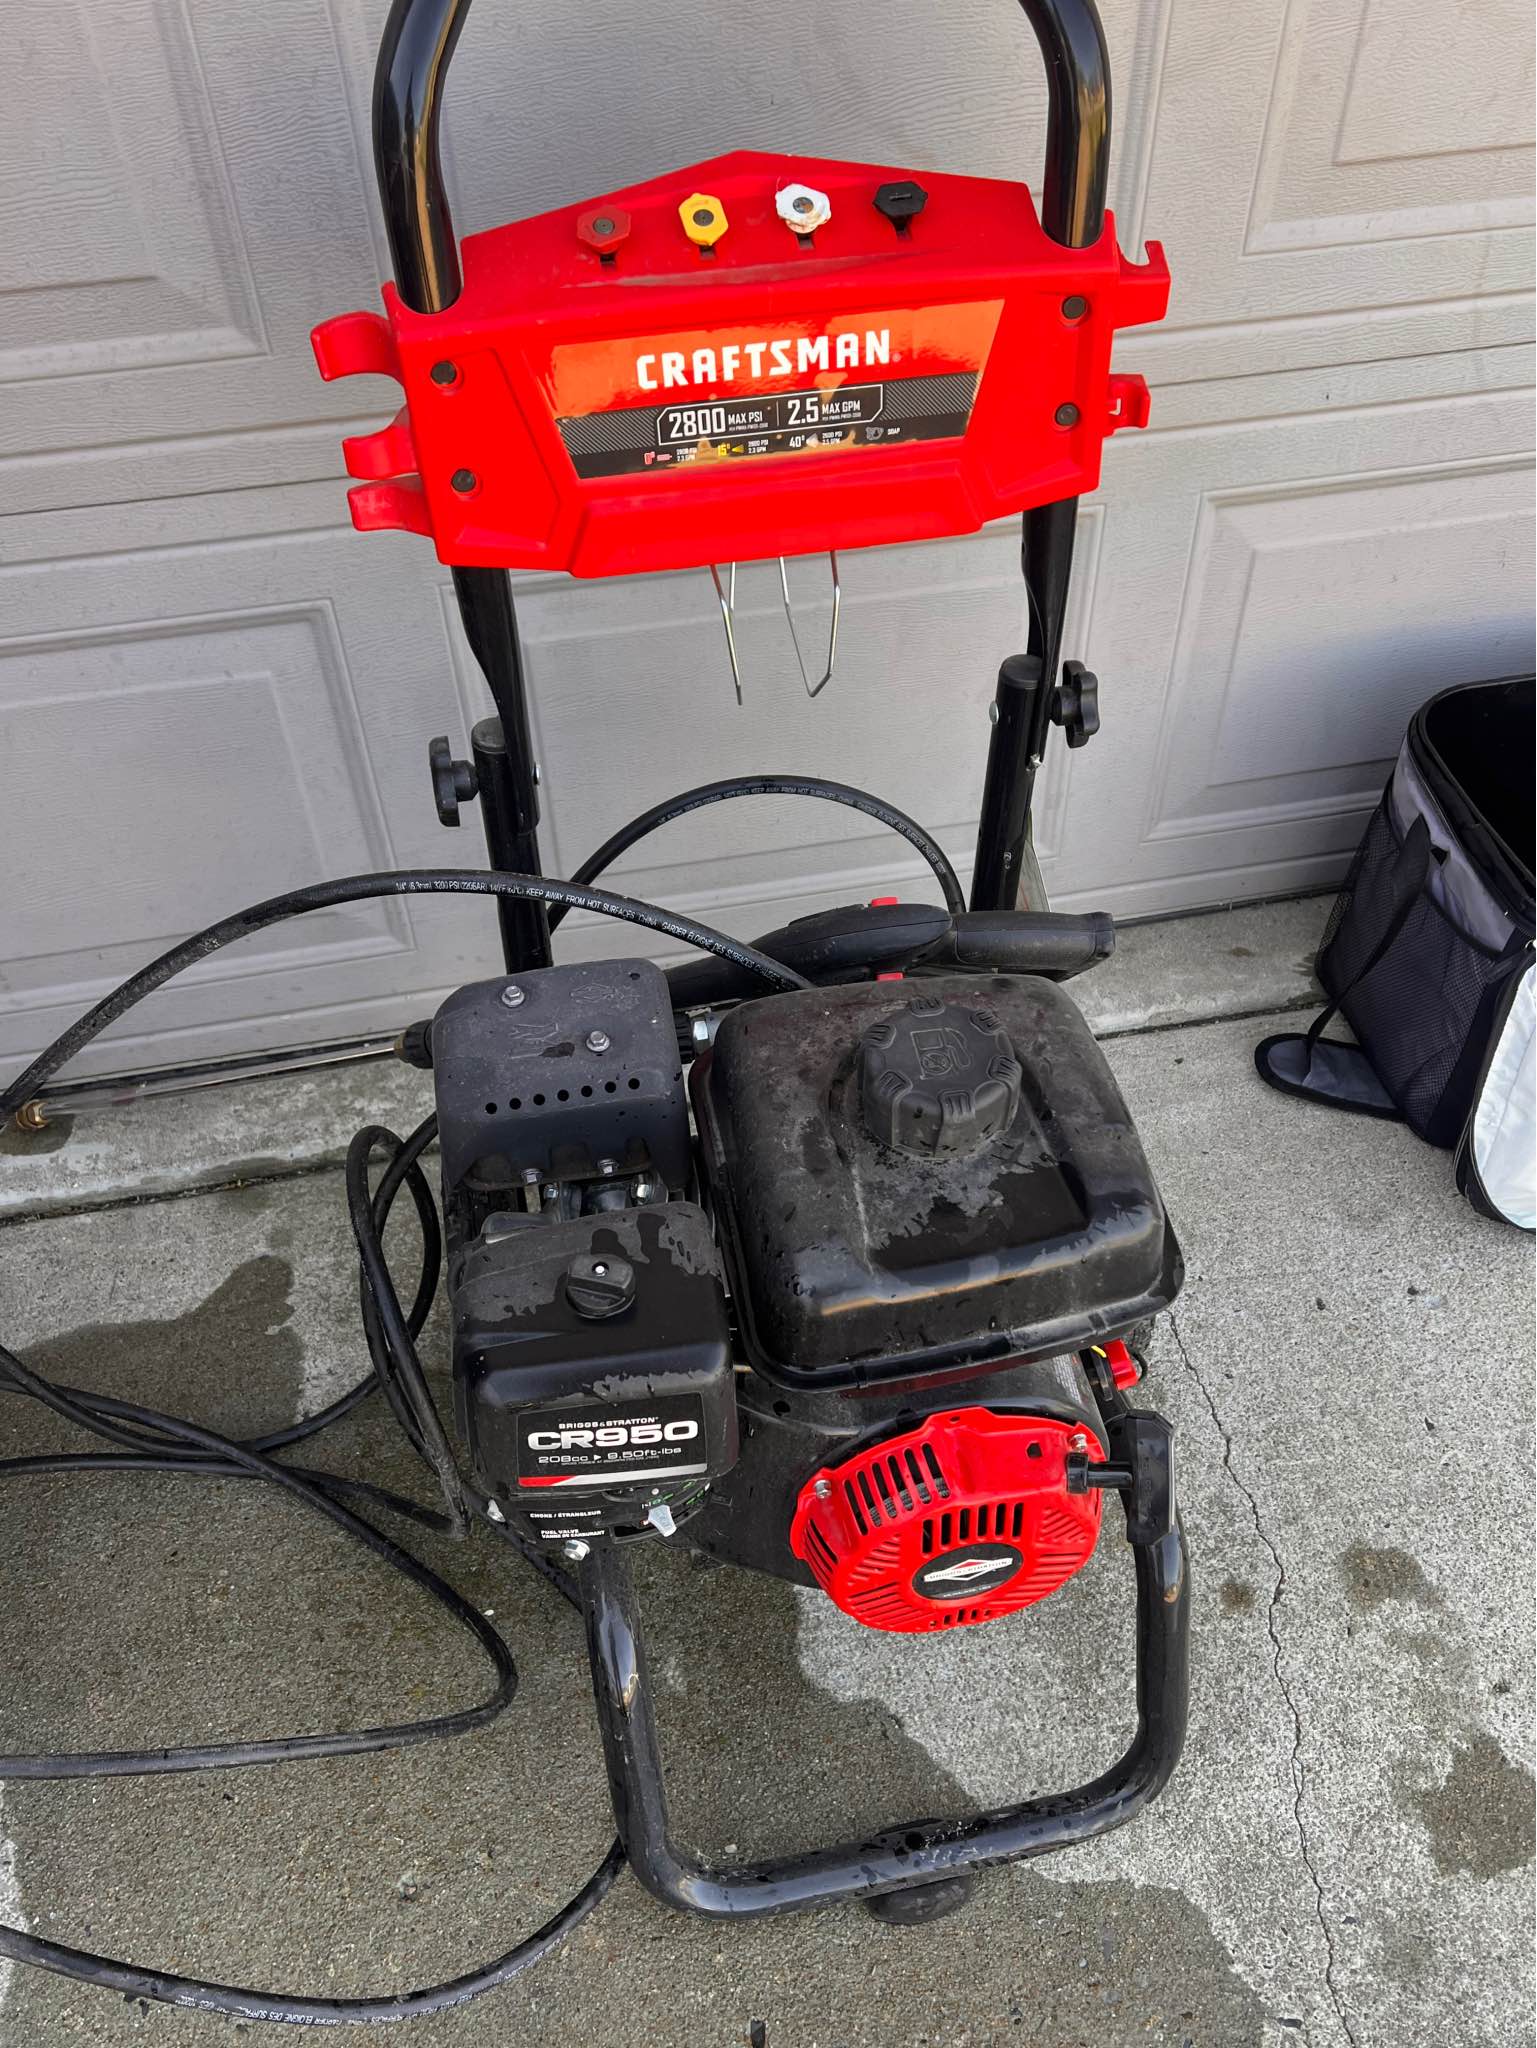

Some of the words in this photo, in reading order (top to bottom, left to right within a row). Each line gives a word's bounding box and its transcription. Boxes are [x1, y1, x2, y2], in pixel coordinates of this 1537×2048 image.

[636, 329, 891, 389] CRAFTSMAN
[669, 407, 726, 438] 2800
[728, 413, 747, 425] MAX
[748, 411, 763, 423] PSI
[788, 397, 819, 425] 2.5
[822, 402, 840, 415] MAX
[842, 400, 861, 412] GPM
[526, 887, 544, 898] KEEP
[545, 890, 564, 901] AWAY
[566, 894, 586, 905] FROM
[587, 899, 602, 909] HOT
[603, 904, 636, 920] SURFACES
[661, 921, 687, 937] GARDER
[527, 1420, 699, 1451] CR950
[538, 1455, 589, 1464] 208cc
[269, 2011, 283, 2021] DES
